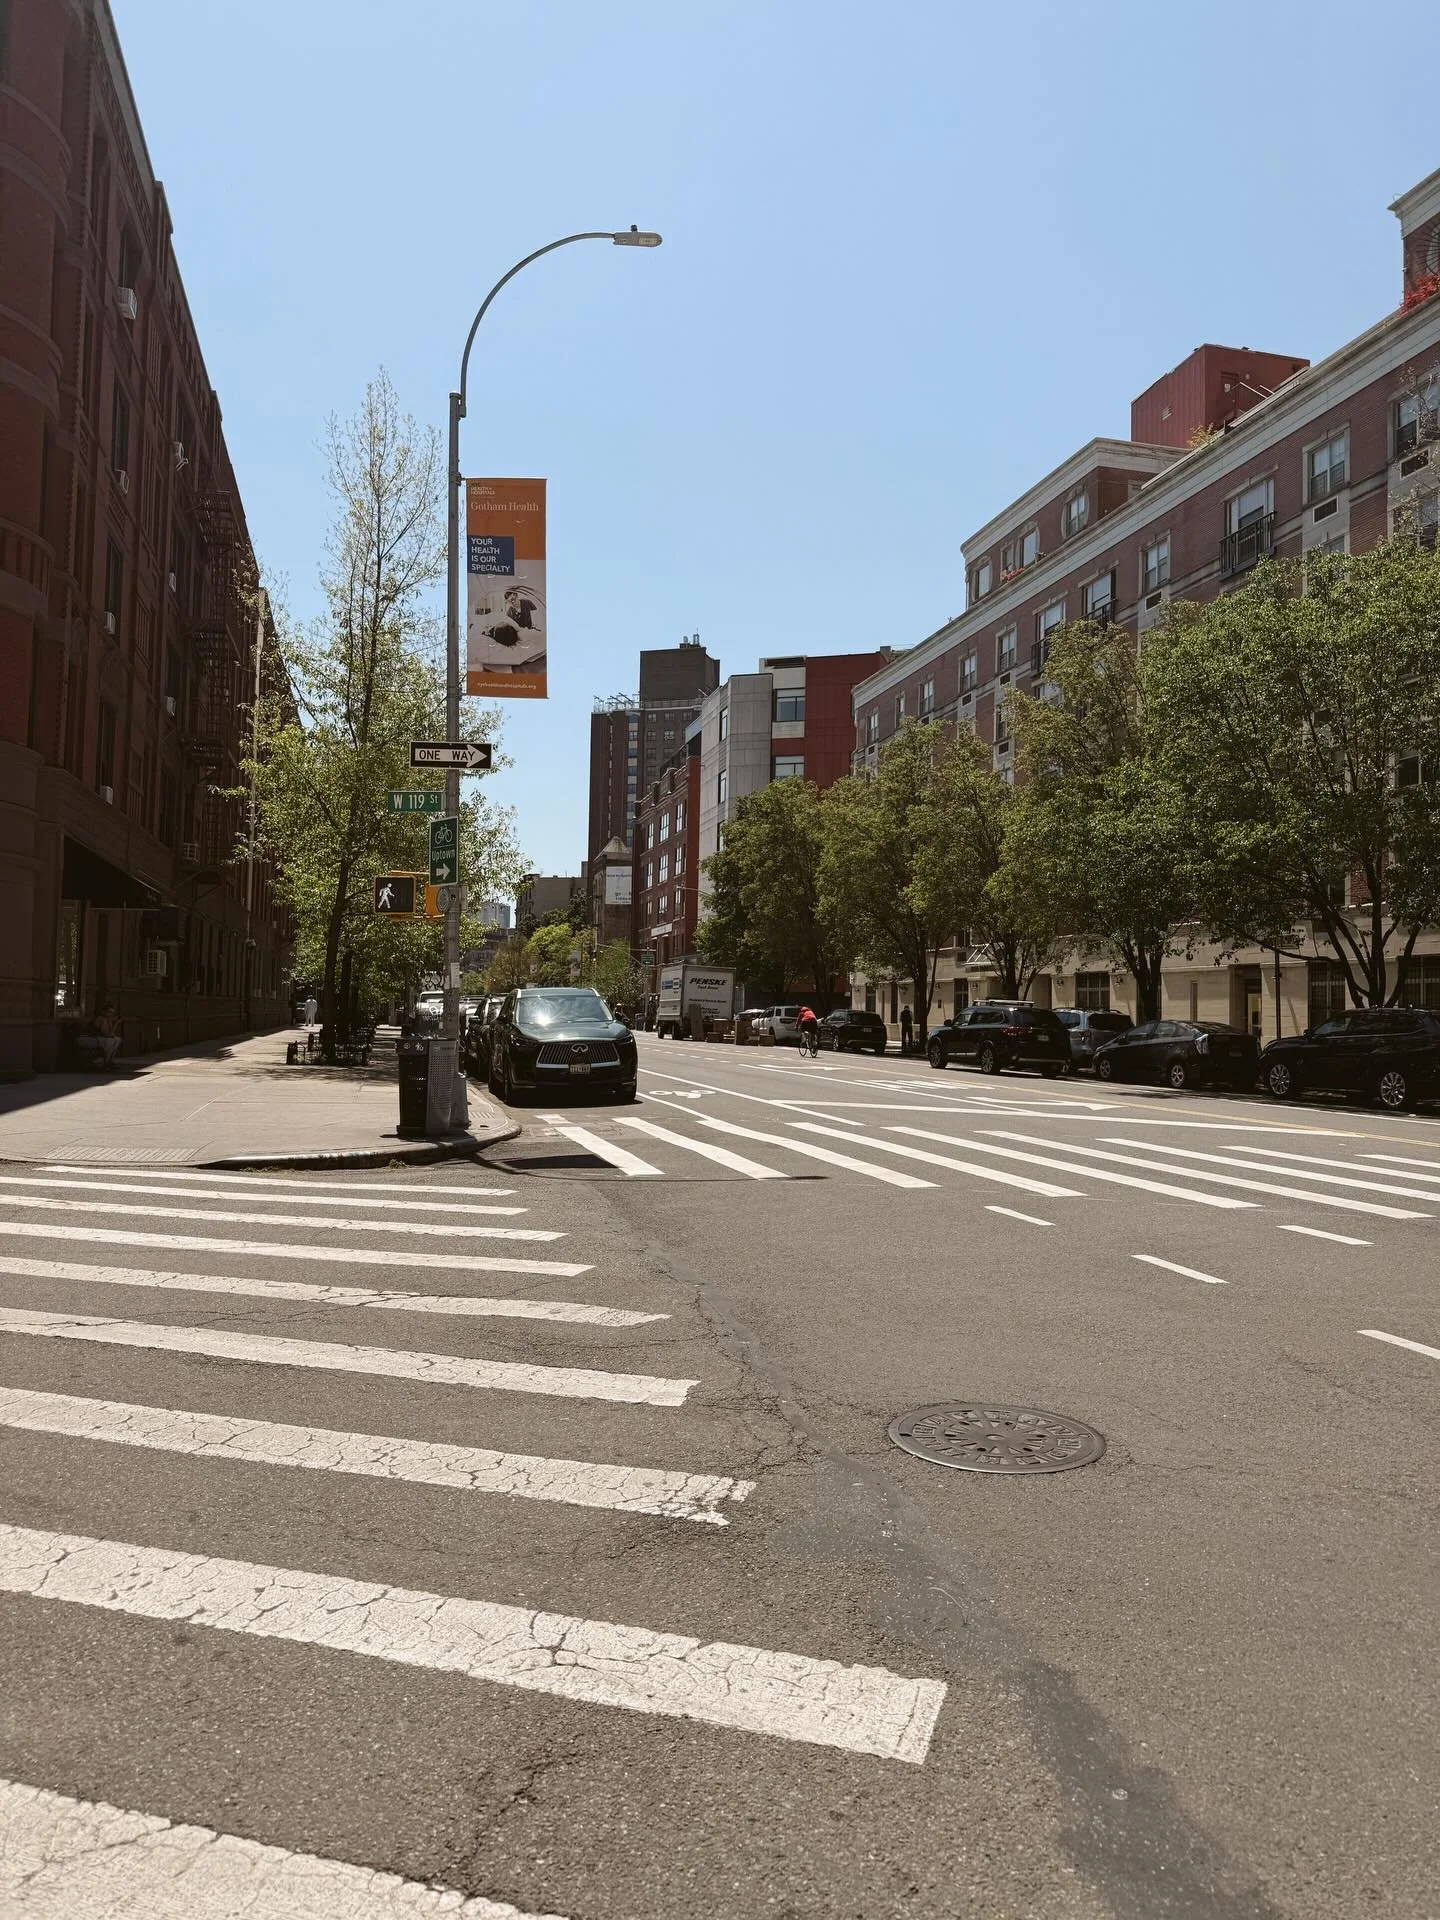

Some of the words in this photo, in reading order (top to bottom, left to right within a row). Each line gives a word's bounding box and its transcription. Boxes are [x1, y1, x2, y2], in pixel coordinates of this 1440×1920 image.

[471, 502, 507, 511] Gotham
[509, 502, 539, 511] Health
[471, 546, 500, 554] HEALTH
[471, 564, 511, 573] SPECIALTY
[419, 750, 440, 760] ONE
[452, 751, 475, 760] WAY
[393, 794, 403, 809] W
[409, 794, 425, 810] 119
[430, 794, 439, 803] St
[432, 849, 455, 863] Uptown
[689, 977, 727, 986] PENSKE
